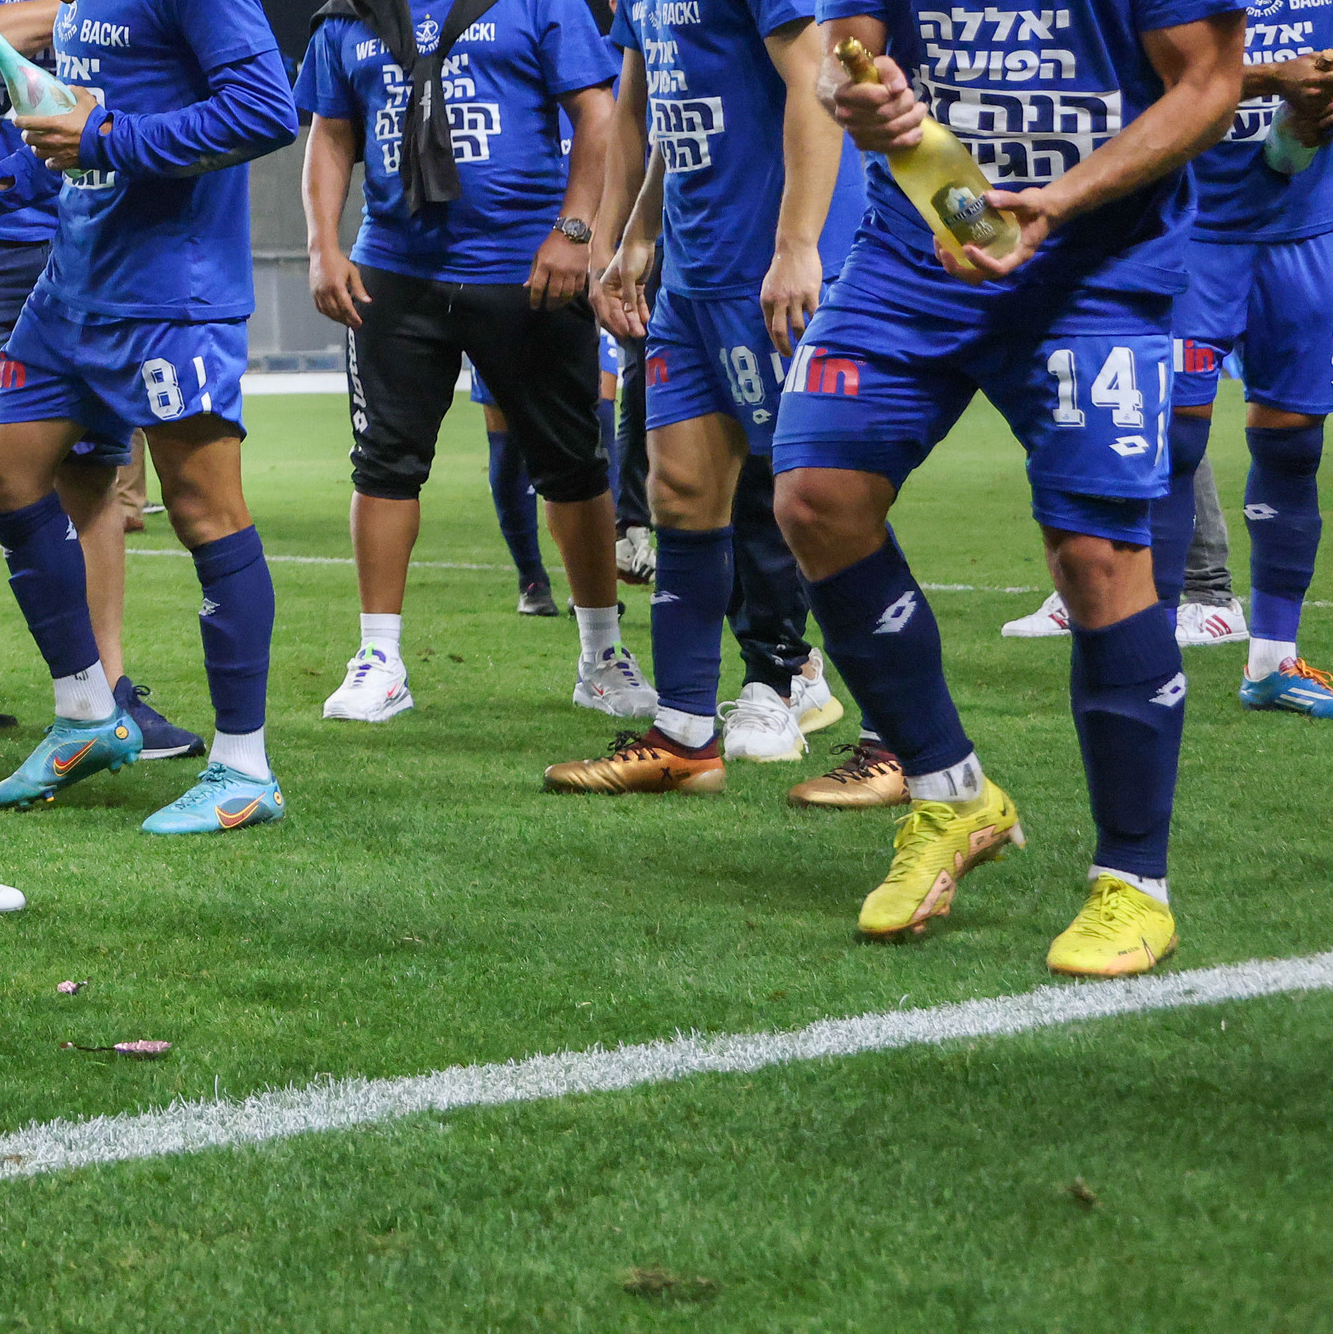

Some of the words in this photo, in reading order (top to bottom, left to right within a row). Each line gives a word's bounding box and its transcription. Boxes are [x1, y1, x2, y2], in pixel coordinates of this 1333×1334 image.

[79, 18, 131, 48] BACK!
[662, 1, 701, 26] BACK!
[918, 6, 1070, 42] יאללה
[977, 93, 1108, 134] הנה
[141, 357, 186, 421] 8
[719, 345, 766, 406] 18
[1047, 346, 1144, 428] 14
